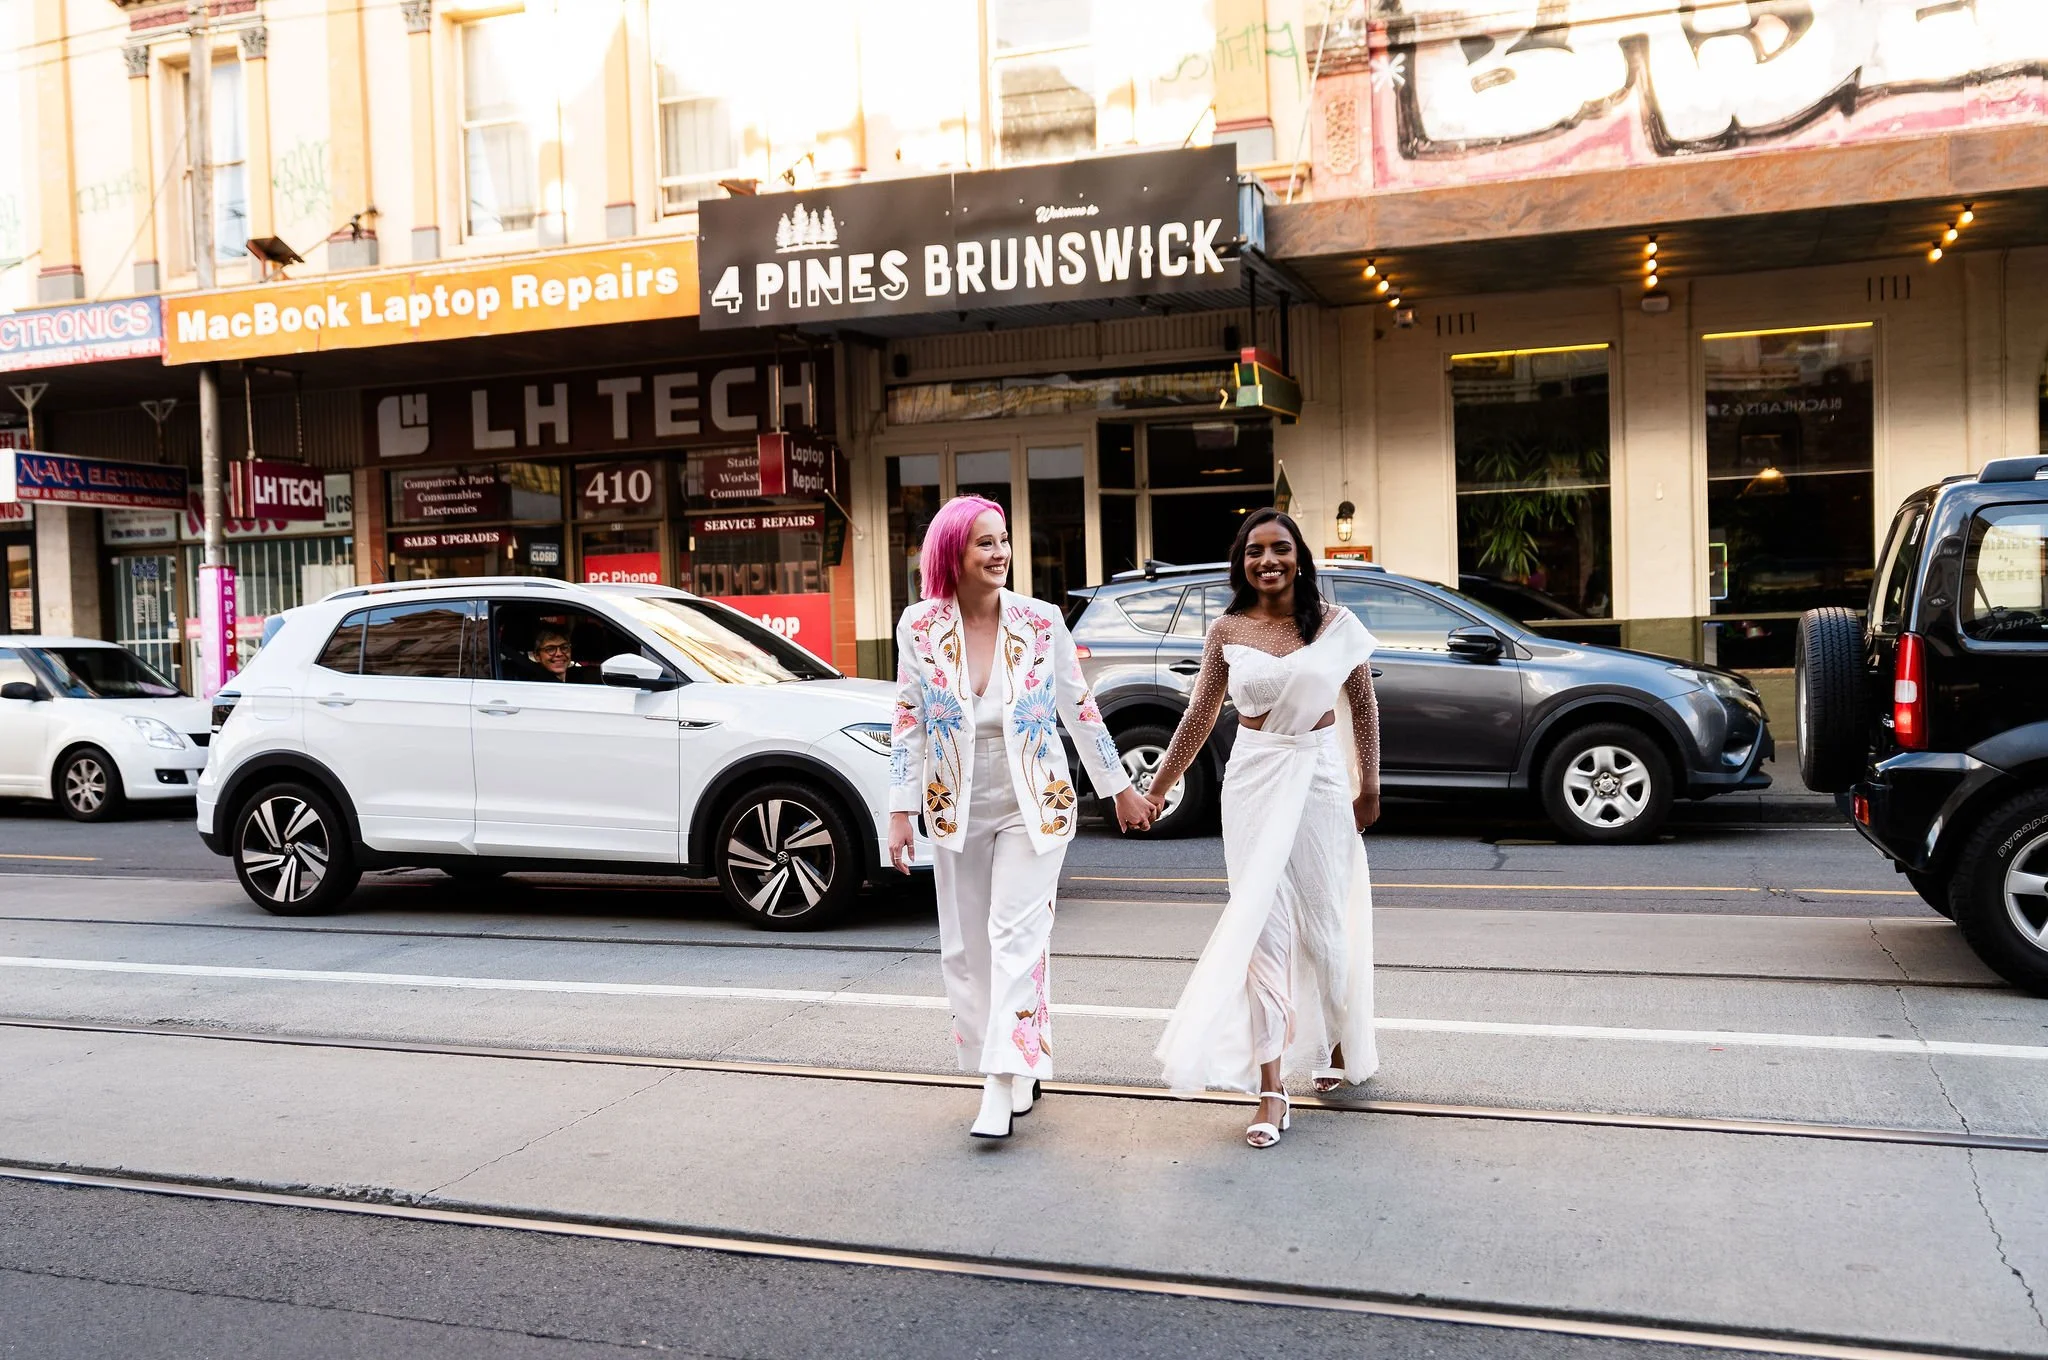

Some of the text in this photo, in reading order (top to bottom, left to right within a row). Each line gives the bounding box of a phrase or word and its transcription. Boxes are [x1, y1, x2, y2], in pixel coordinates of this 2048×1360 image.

[1035, 204, 1087, 224] Welcome
[924, 217, 1226, 297] BRUNSWICK
[711, 248, 910, 314] 4 PINES
[177, 262, 679, 344] MacBook Laptop Repairs
[471, 361, 817, 451] LH TECH
[791, 441, 825, 468] Laptop
[18, 456, 85, 487] NAVA
[404, 474, 495, 491] Computers & Parts
[792, 469, 825, 494] Repair
[18, 486, 41, 498] NEW
[53, 490, 78, 500] USED
[254, 474, 323, 507] LH TECH
[416, 489, 482, 503] Consumables
[585, 469, 652, 504] 410
[423, 503, 478, 517] Electronics
[704, 515, 816, 532] SERVICE REPAIRS
[404, 531, 500, 548] SALES UPGRADES
[531, 551, 557, 562] CLOSED
[588, 570, 658, 584] PC Phone
